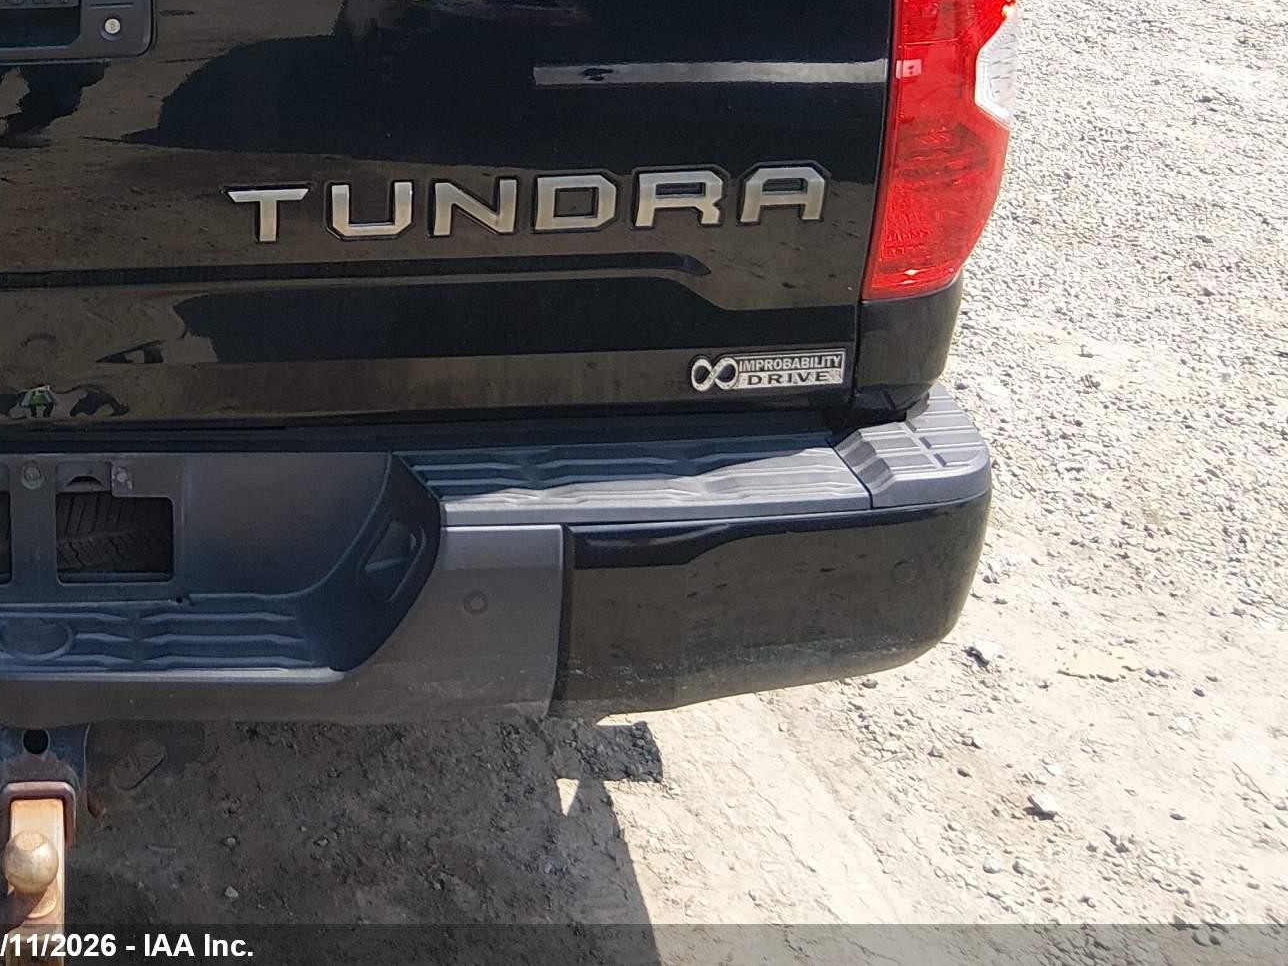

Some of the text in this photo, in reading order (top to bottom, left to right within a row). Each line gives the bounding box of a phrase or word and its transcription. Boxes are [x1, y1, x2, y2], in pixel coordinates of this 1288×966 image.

[224, 166, 826, 243] TUNDRA
[739, 355, 842, 372] IMPROBABILITY
[748, 371, 830, 386] DRIVE
